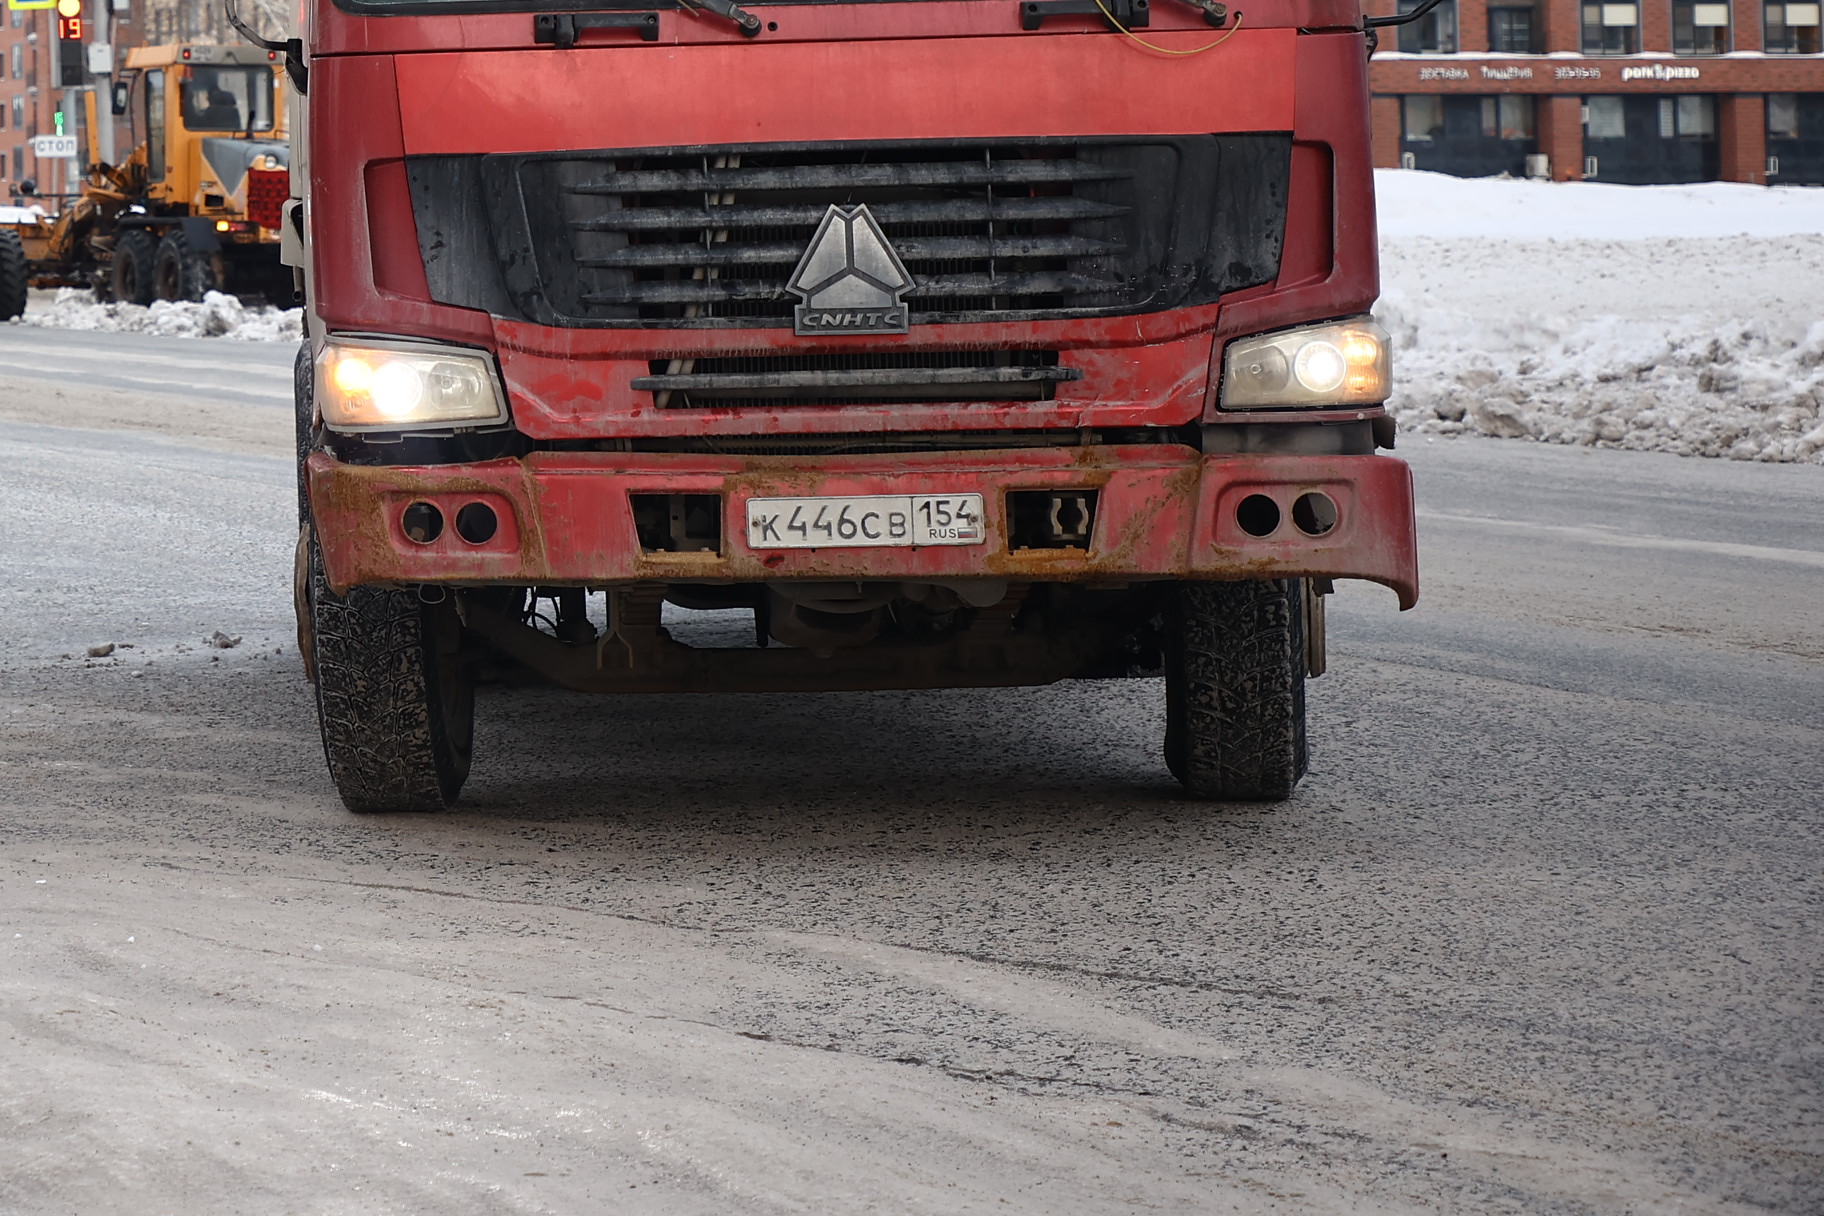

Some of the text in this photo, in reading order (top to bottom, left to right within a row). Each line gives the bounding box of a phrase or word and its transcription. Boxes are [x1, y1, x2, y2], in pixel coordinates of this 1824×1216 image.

[59, 18, 82, 39] 19
[37, 140, 75, 153] СТОП
[802, 311, 901, 328] CNHTC
[918, 499, 973, 528] 154
[929, 528, 957, 539] RUS
